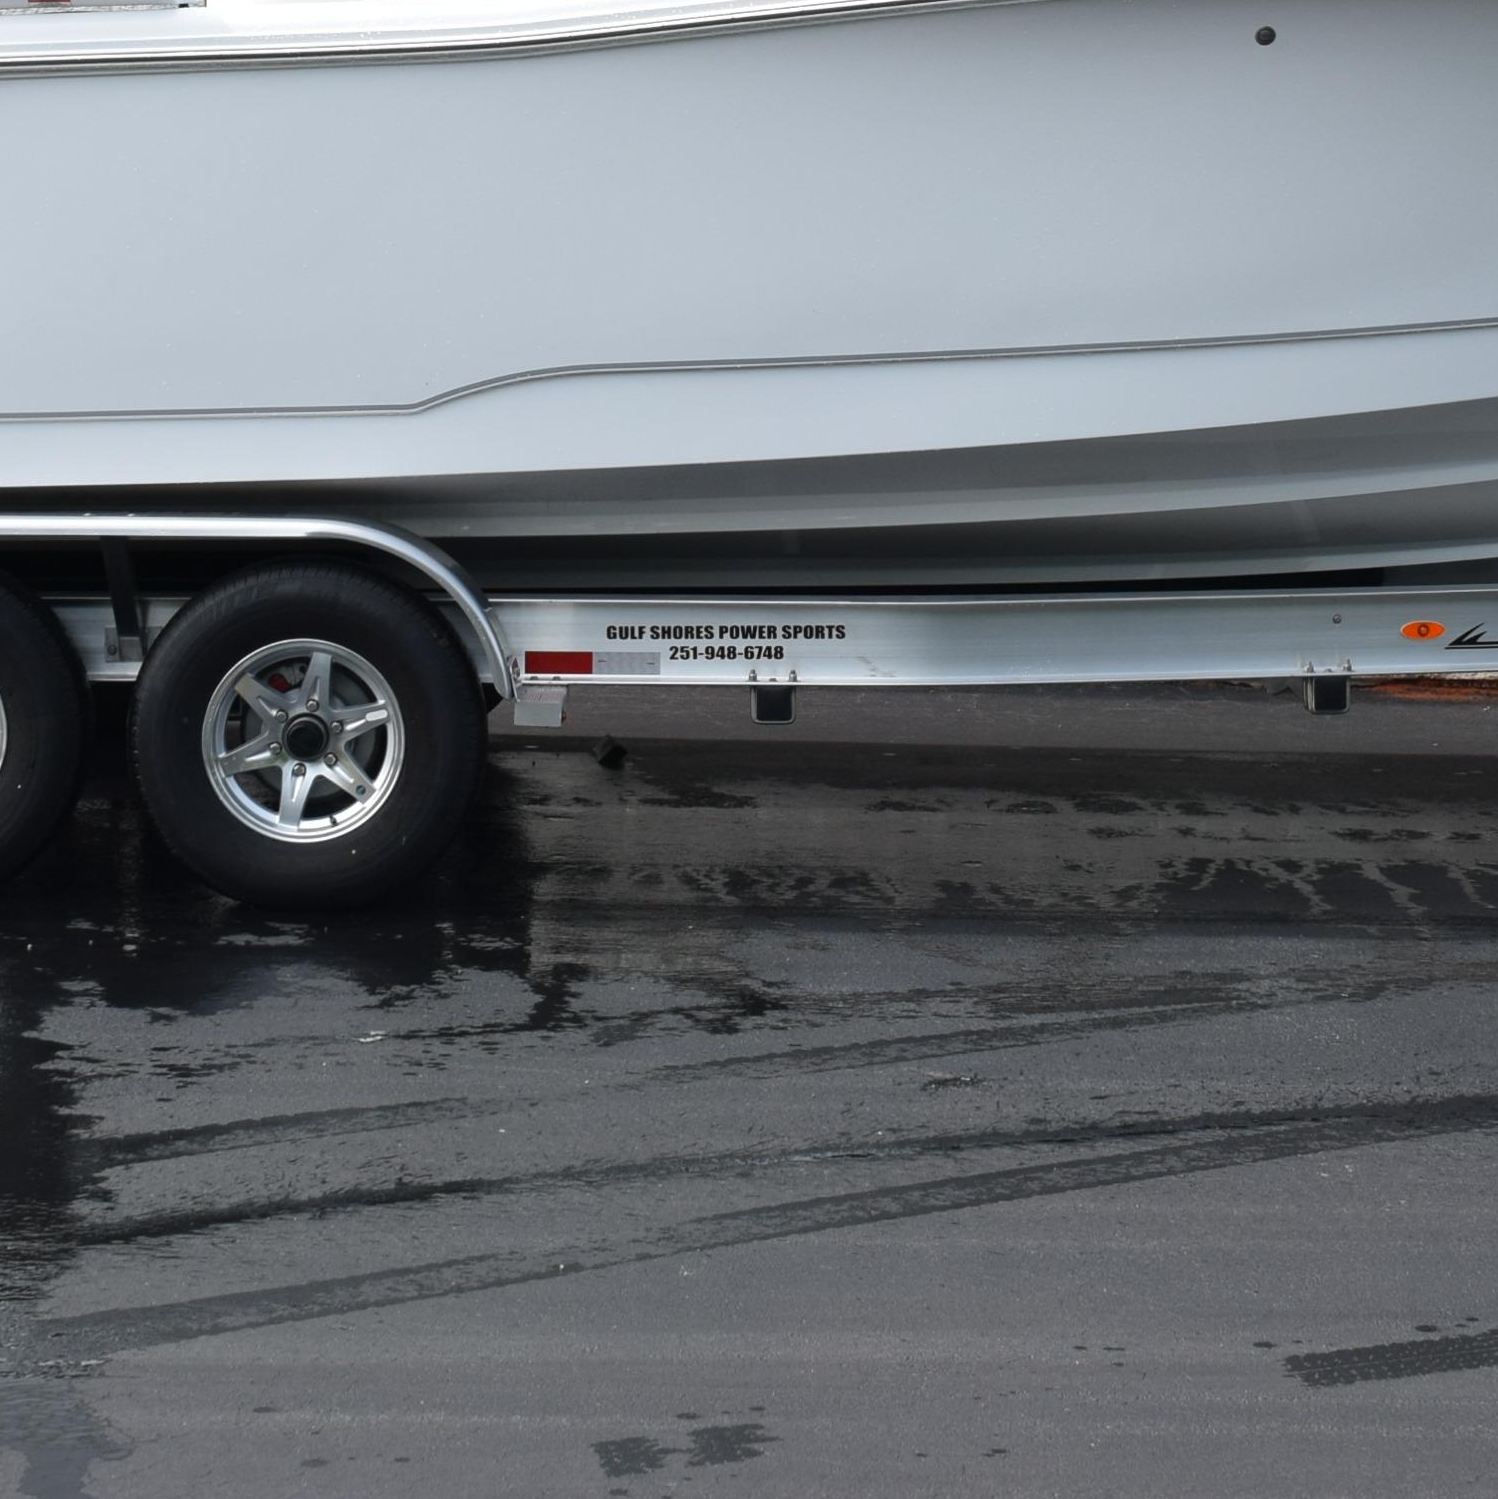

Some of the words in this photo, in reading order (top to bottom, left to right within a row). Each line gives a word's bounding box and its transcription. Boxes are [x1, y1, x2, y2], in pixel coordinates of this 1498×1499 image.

[606, 625, 646, 640] GULF
[650, 625, 714, 640] SHORES
[719, 624, 778, 640] POWER
[782, 624, 846, 640] SPORTS
[669, 645, 784, 660] 251-948-6748
